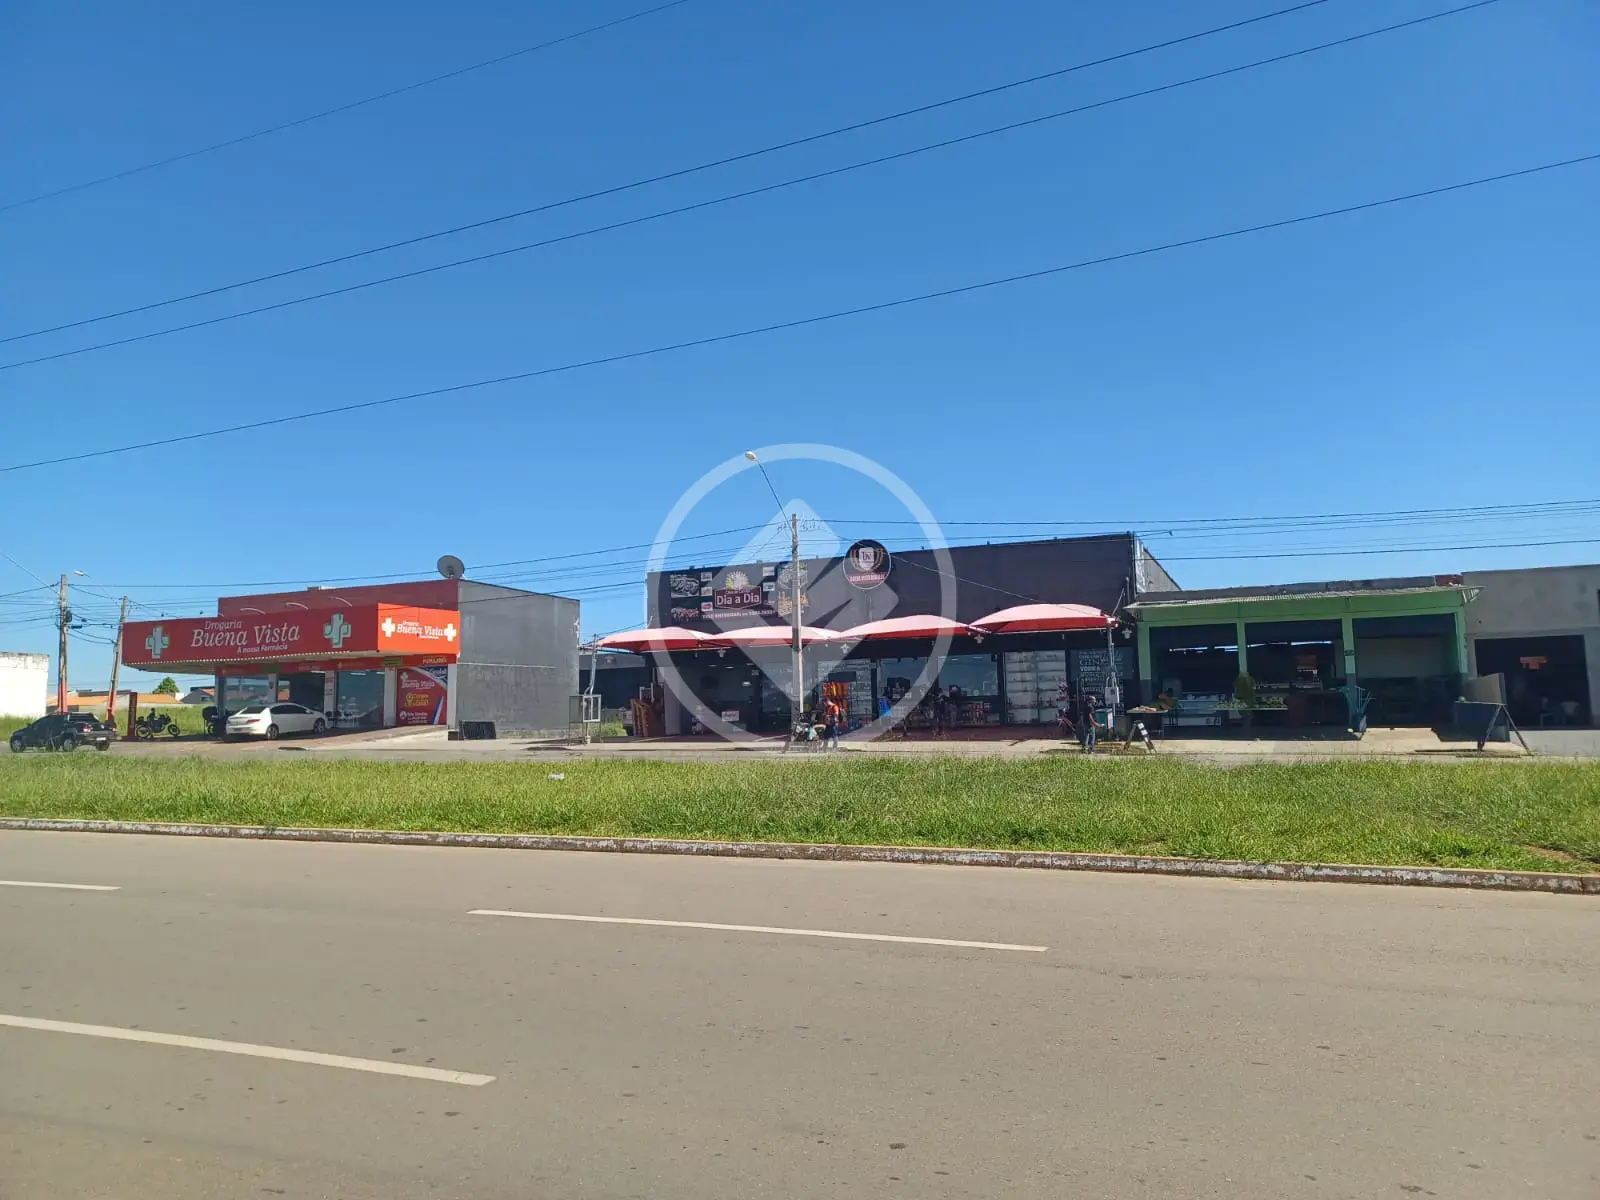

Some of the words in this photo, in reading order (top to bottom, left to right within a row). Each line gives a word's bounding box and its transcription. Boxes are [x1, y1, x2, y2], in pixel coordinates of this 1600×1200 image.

[716, 595, 733, 605] Dia
[735, 596, 741, 604] a
[743, 593, 760, 603] Dia
[204, 620, 242, 631] Drogaria
[191, 629, 248, 647] Buena
[253, 622, 300, 644] Vista
